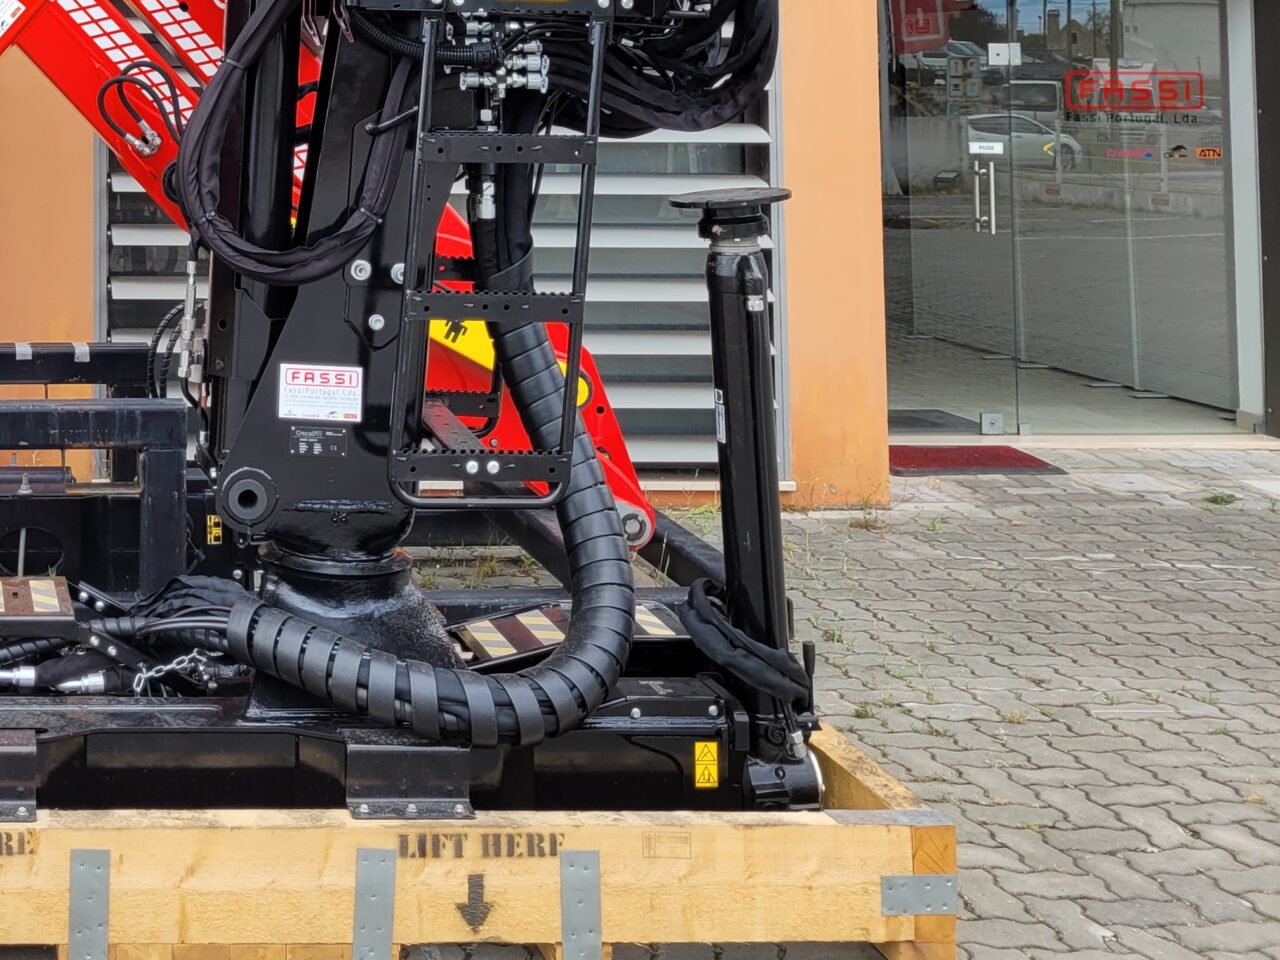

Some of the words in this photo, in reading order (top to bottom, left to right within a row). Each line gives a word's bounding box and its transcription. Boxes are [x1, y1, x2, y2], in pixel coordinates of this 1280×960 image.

[1078, 78, 1191, 102] FASSI
[291, 371, 353, 385] FASSI
[397, 832, 468, 859] LIFT
